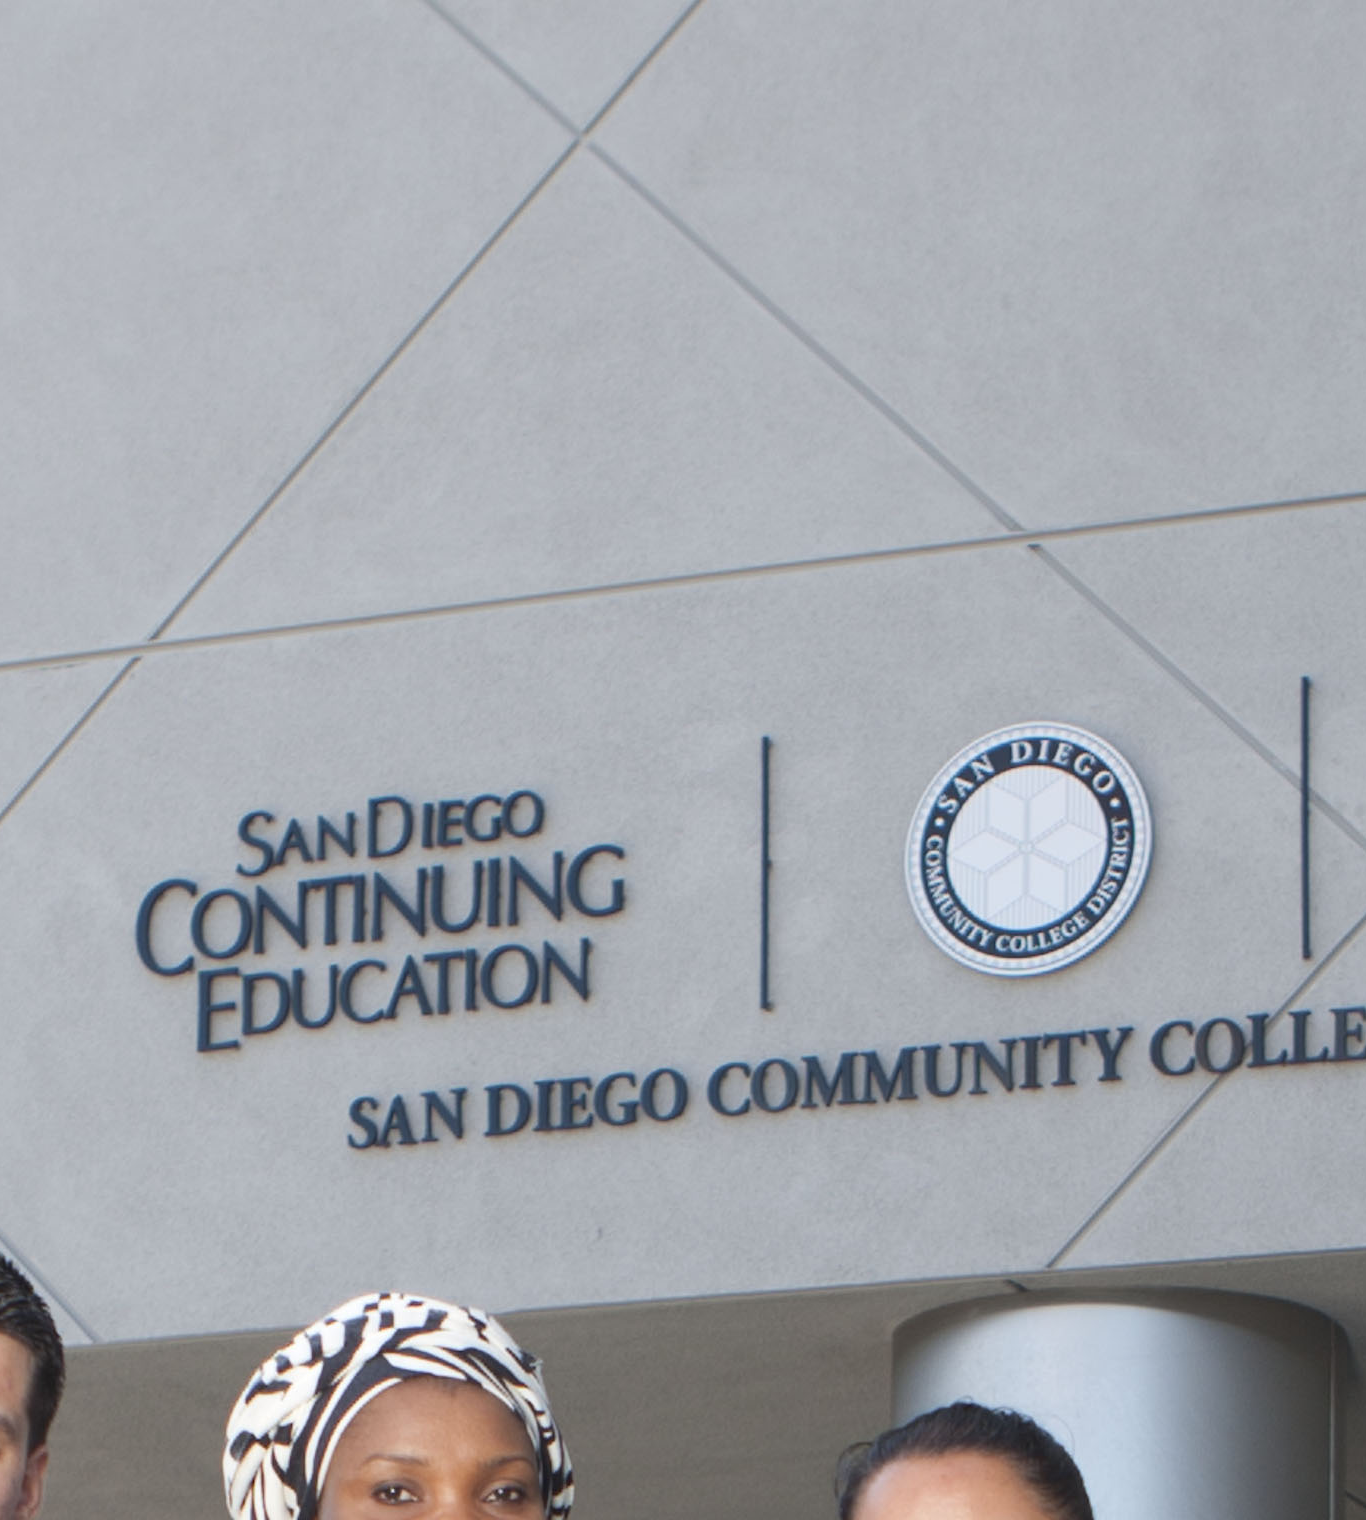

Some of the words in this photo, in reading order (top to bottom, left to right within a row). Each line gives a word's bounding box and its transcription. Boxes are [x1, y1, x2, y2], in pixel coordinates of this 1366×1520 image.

[236, 810, 358, 879] SAN
[367, 790, 547, 860] DIEGO
[937, 754, 995, 814] SAN
[1010, 740, 1117, 795] DIEGO
[135, 844, 628, 978] CONTINUING
[924, 834, 994, 947] COMMUNITY
[995, 912, 1087, 953] COLLEGE
[1086, 816, 1132, 917] DISTRICT
[196, 937, 594, 1054] EDUCATION
[347, 1087, 469, 1151] SAN
[483, 1067, 691, 1139] DIEGO
[706, 1026, 1135, 1118] COMMUNITY
